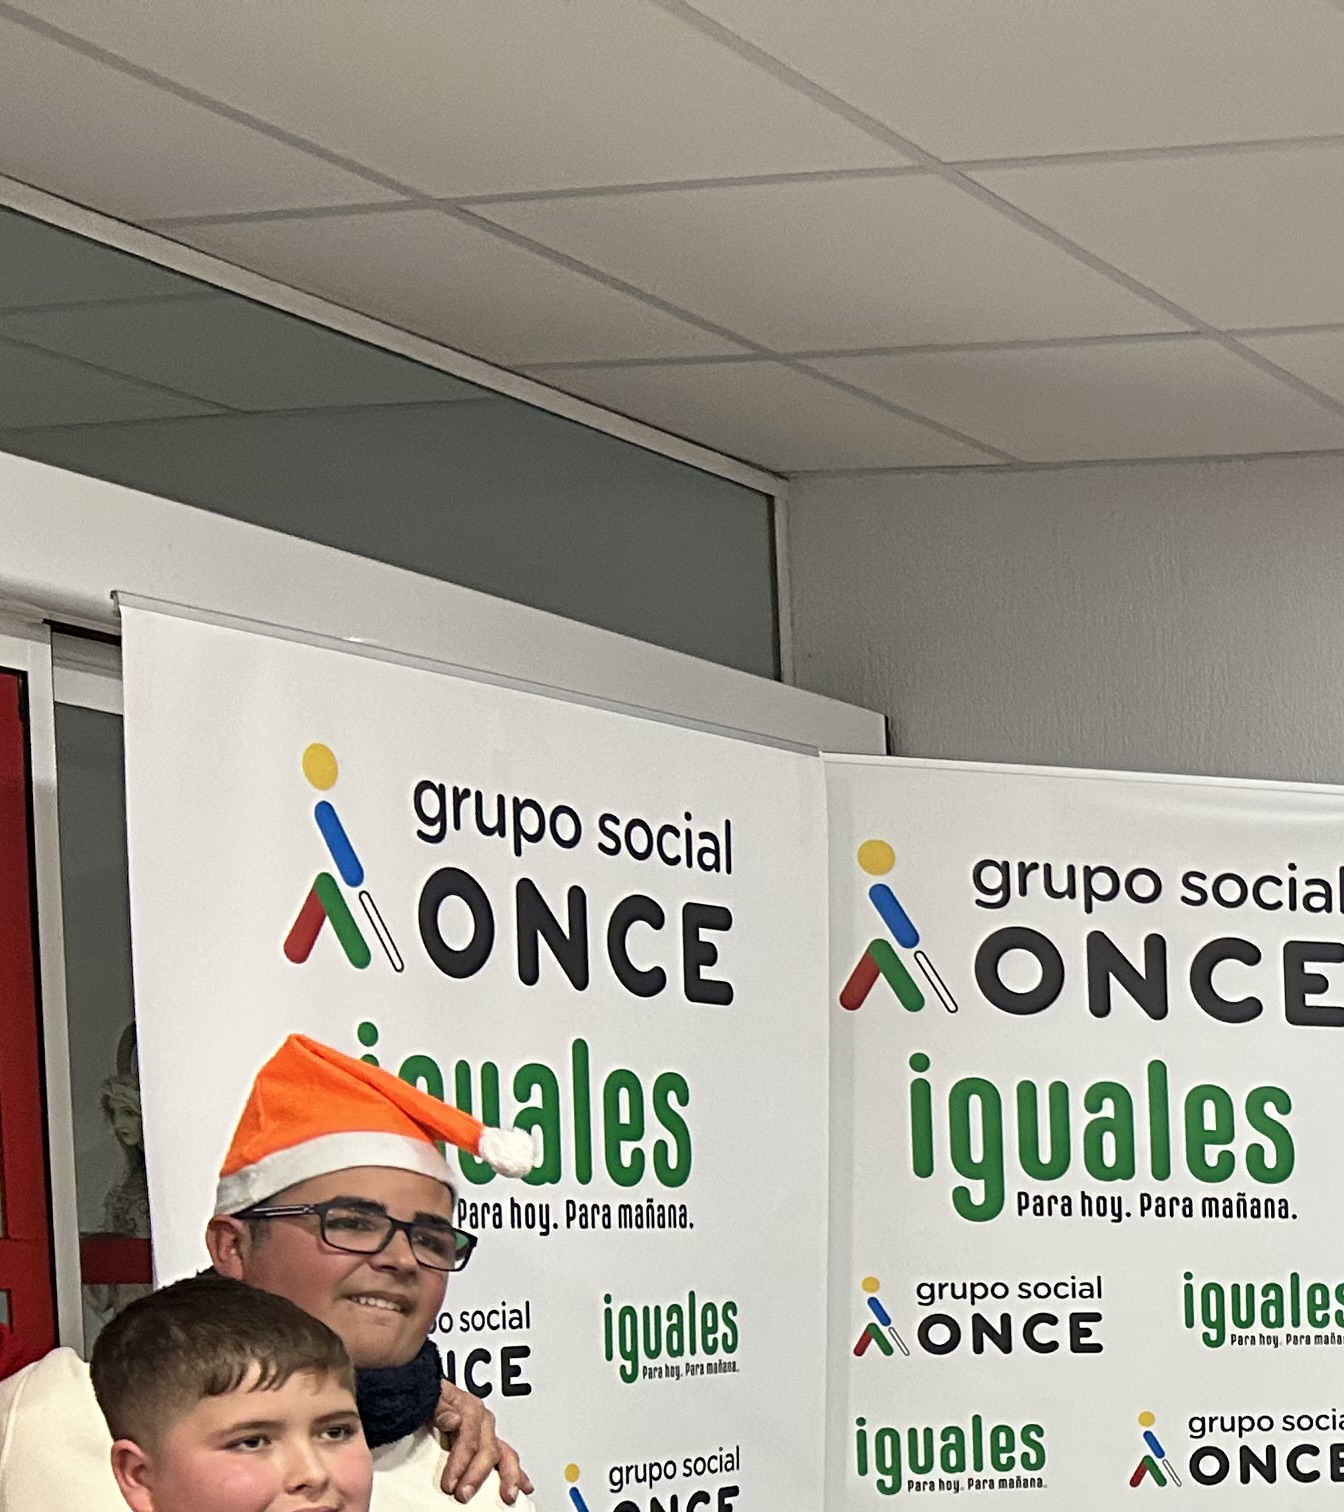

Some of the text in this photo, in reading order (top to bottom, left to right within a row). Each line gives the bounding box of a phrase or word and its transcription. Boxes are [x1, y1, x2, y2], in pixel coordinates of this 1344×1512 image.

[413, 779, 732, 875] grupo social
[972, 858, 1163, 915] grupo
[417, 866, 735, 1007] ONCE
[357, 1021, 692, 1189] uales
[908, 1052, 1295, 1222] iguales
[457, 1196, 694, 1237] Para hoy. Para mañana.
[1017, 1190, 1298, 1224] Para hoy. Para mañana.
[916, 1275, 1102, 1307] grupo social
[459, 1300, 531, 1333] social
[604, 1290, 739, 1384] iguales
[917, 1311, 1104, 1356] ONCE
[1231, 1334, 1254, 1346] Para
[1286, 1334, 1311, 1346] Para
[642, 1363, 663, 1380] Para
[685, 1361, 705, 1376] Para
[1188, 1415, 1275, 1440] grupo
[608, 1444, 740, 1494] grupo social
[855, 1414, 1047, 1496] iguales
[907, 1479, 934, 1493] Para
[967, 1477, 995, 1491] Para
